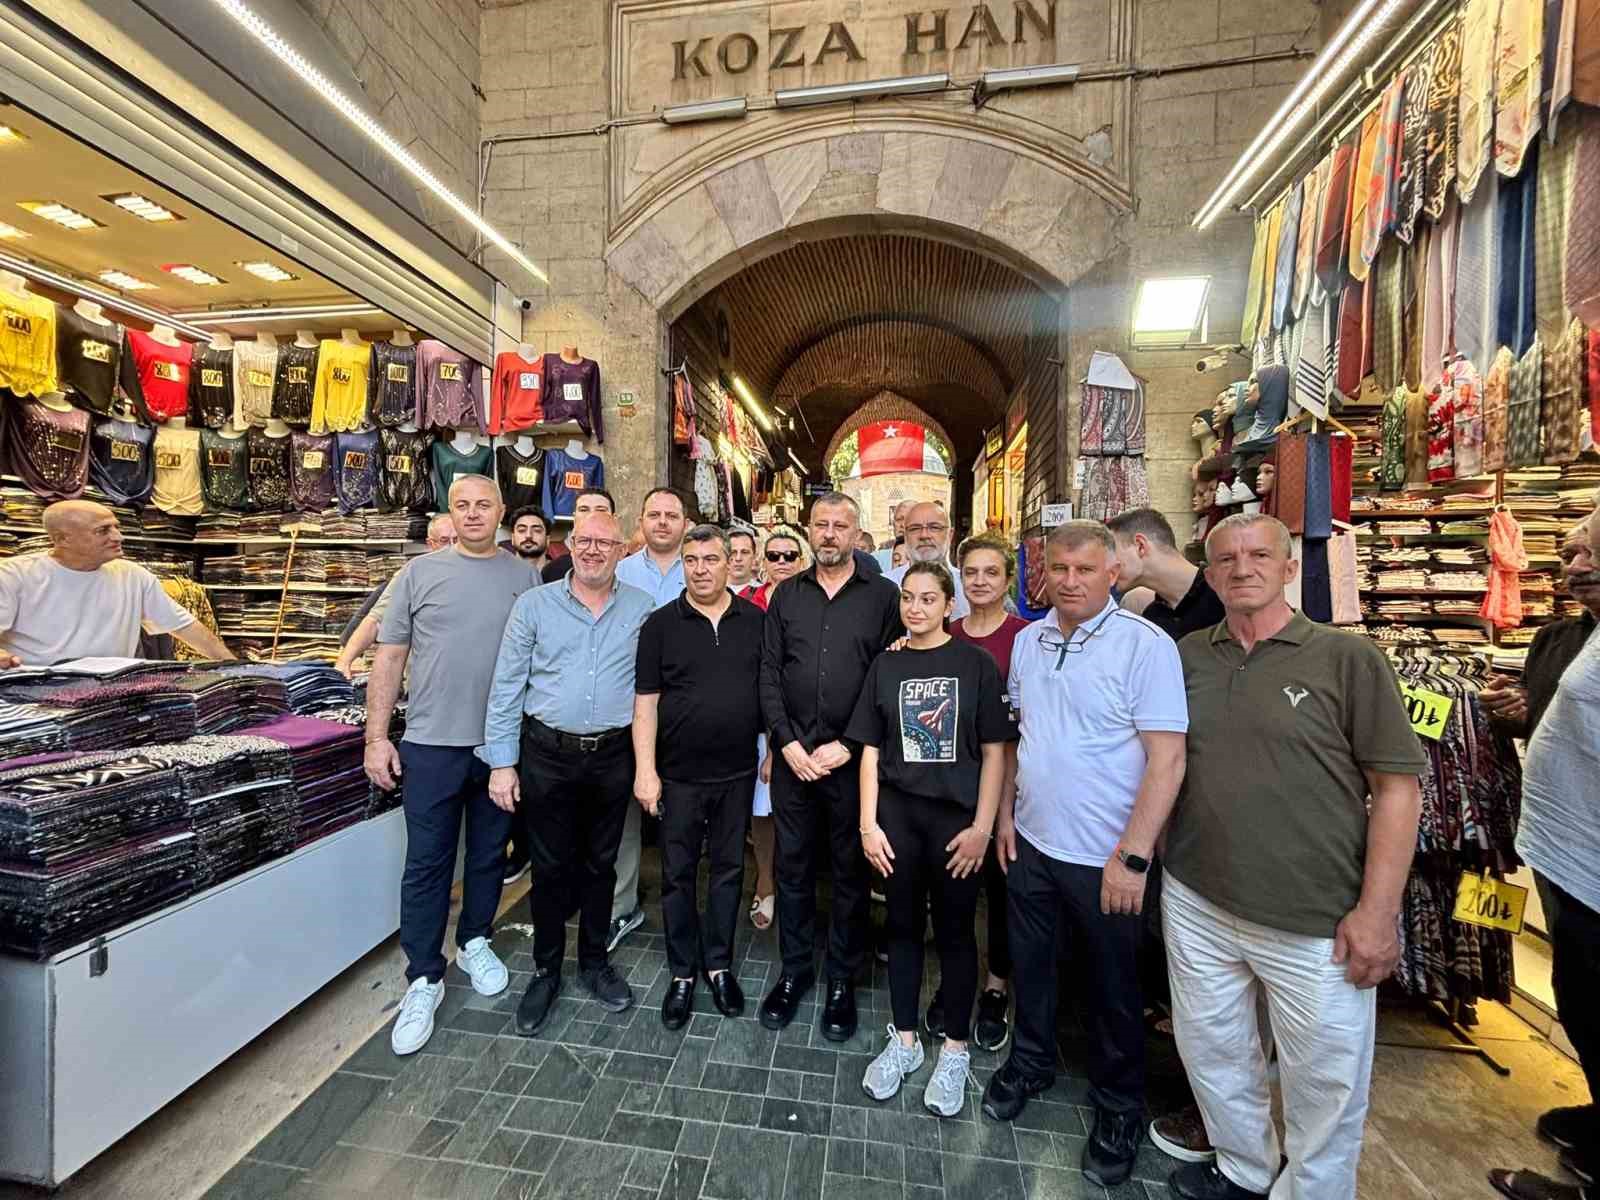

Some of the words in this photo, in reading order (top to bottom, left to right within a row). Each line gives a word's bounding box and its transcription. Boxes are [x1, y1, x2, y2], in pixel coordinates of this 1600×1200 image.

[671, 22, 866, 81] KOZA
[904, 0, 1057, 55] HAN
[112, 443, 137, 459] 500
[159, 454, 181, 467] 500
[904, 680, 949, 699] SPACE
